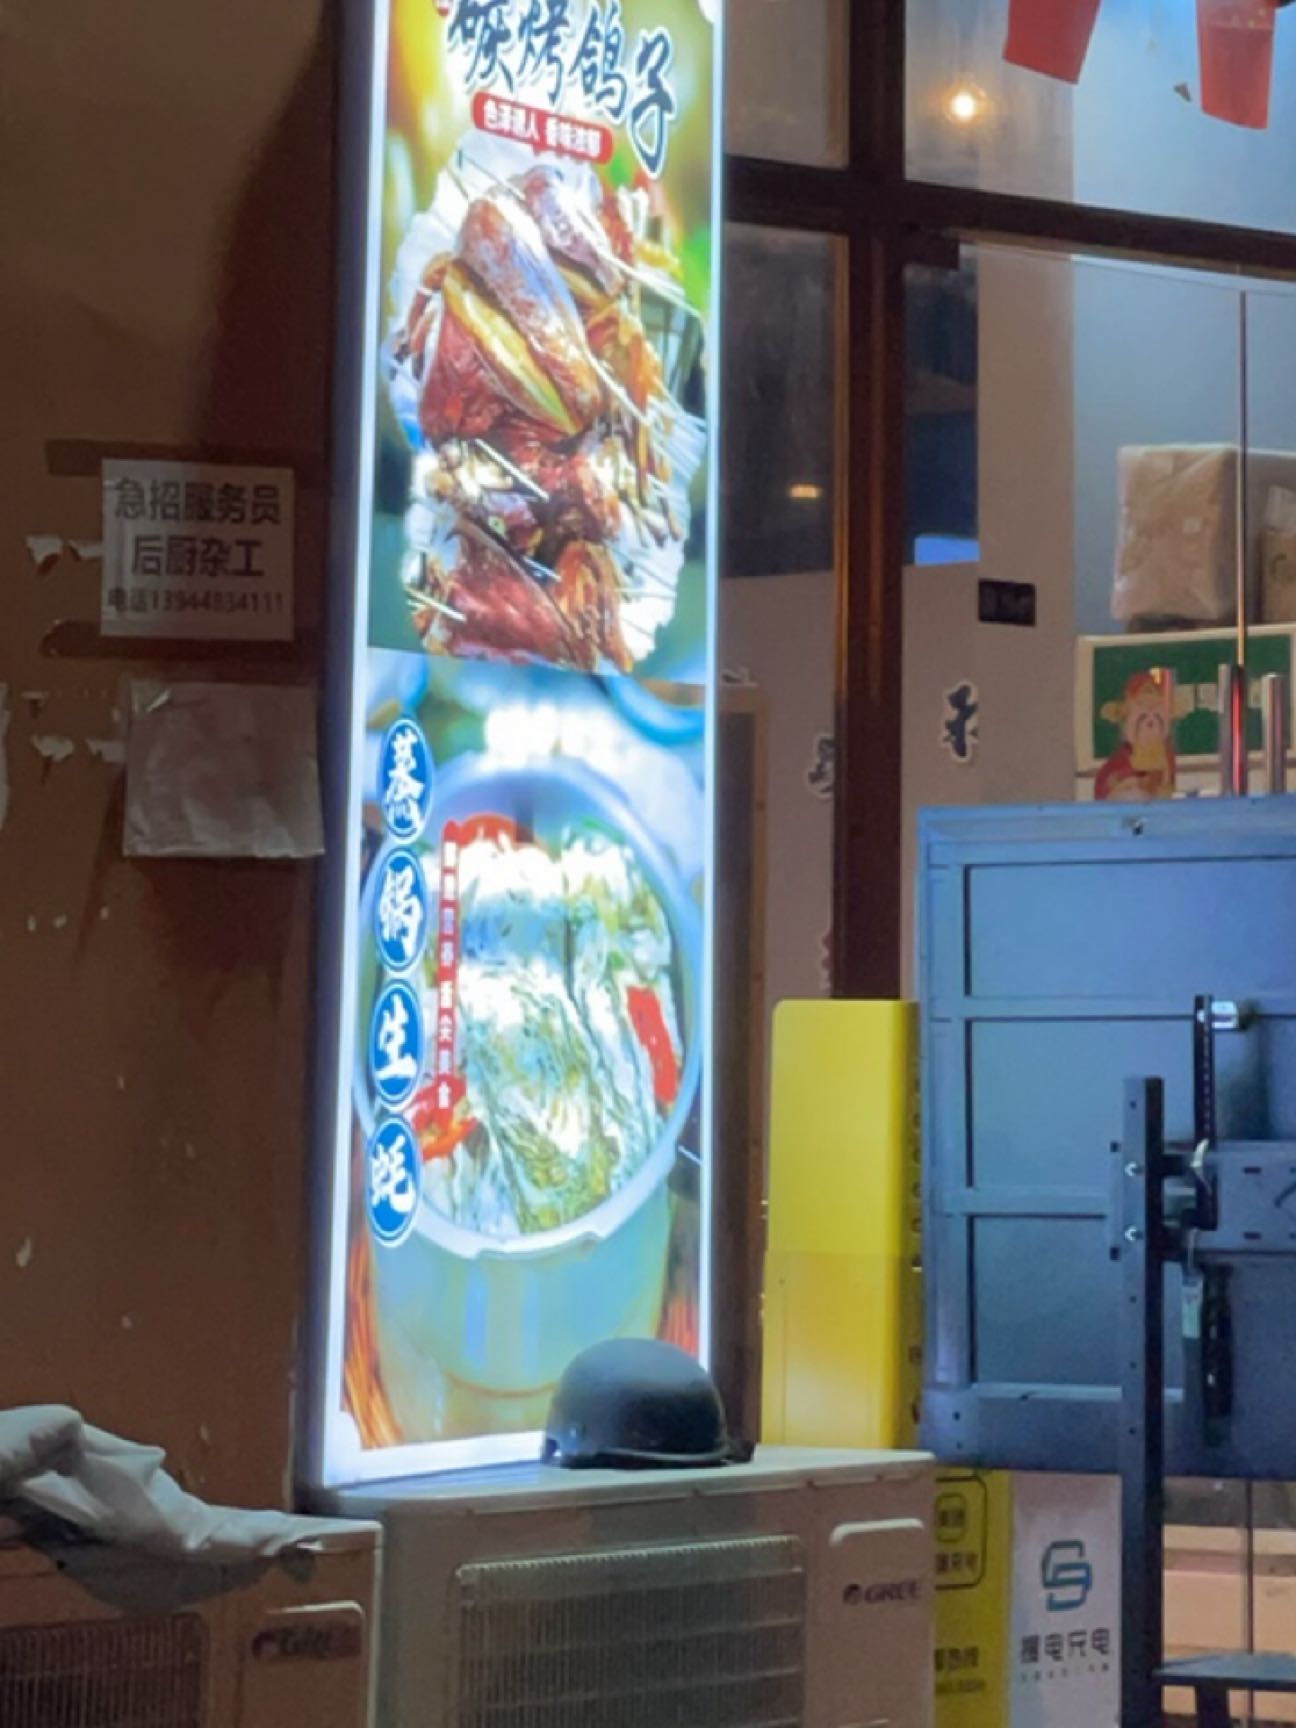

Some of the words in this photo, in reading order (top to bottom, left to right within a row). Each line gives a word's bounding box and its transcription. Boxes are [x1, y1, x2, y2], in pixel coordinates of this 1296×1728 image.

[114, 477, 281, 524] 急招服务员
[131, 534, 265, 577] 后厨杂工
